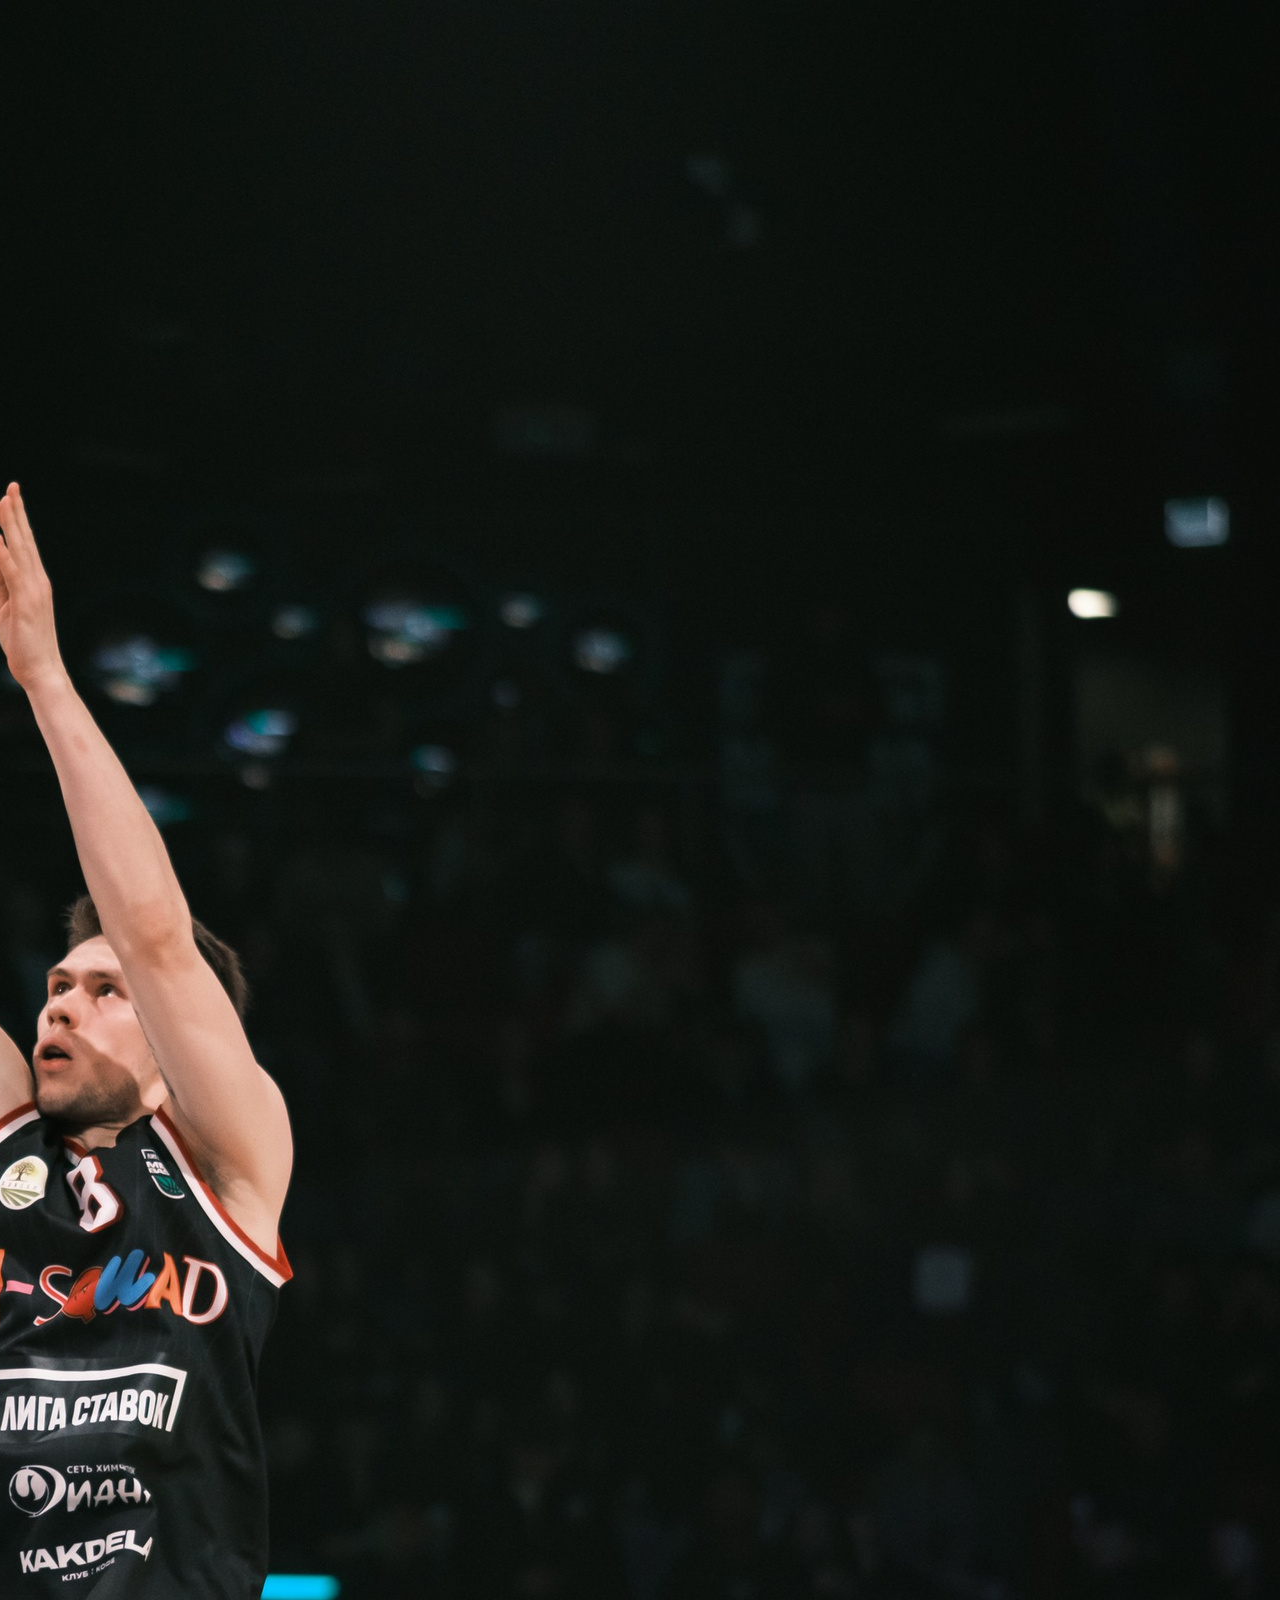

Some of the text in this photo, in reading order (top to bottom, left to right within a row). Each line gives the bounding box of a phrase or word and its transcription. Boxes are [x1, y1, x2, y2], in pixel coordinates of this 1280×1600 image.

[0, 1388, 169, 1431] ЛИГА СТАВОК
[66, 1464, 93, 1474] СЕТЬ
[61, 1570, 89, 1582] КЛУБ
